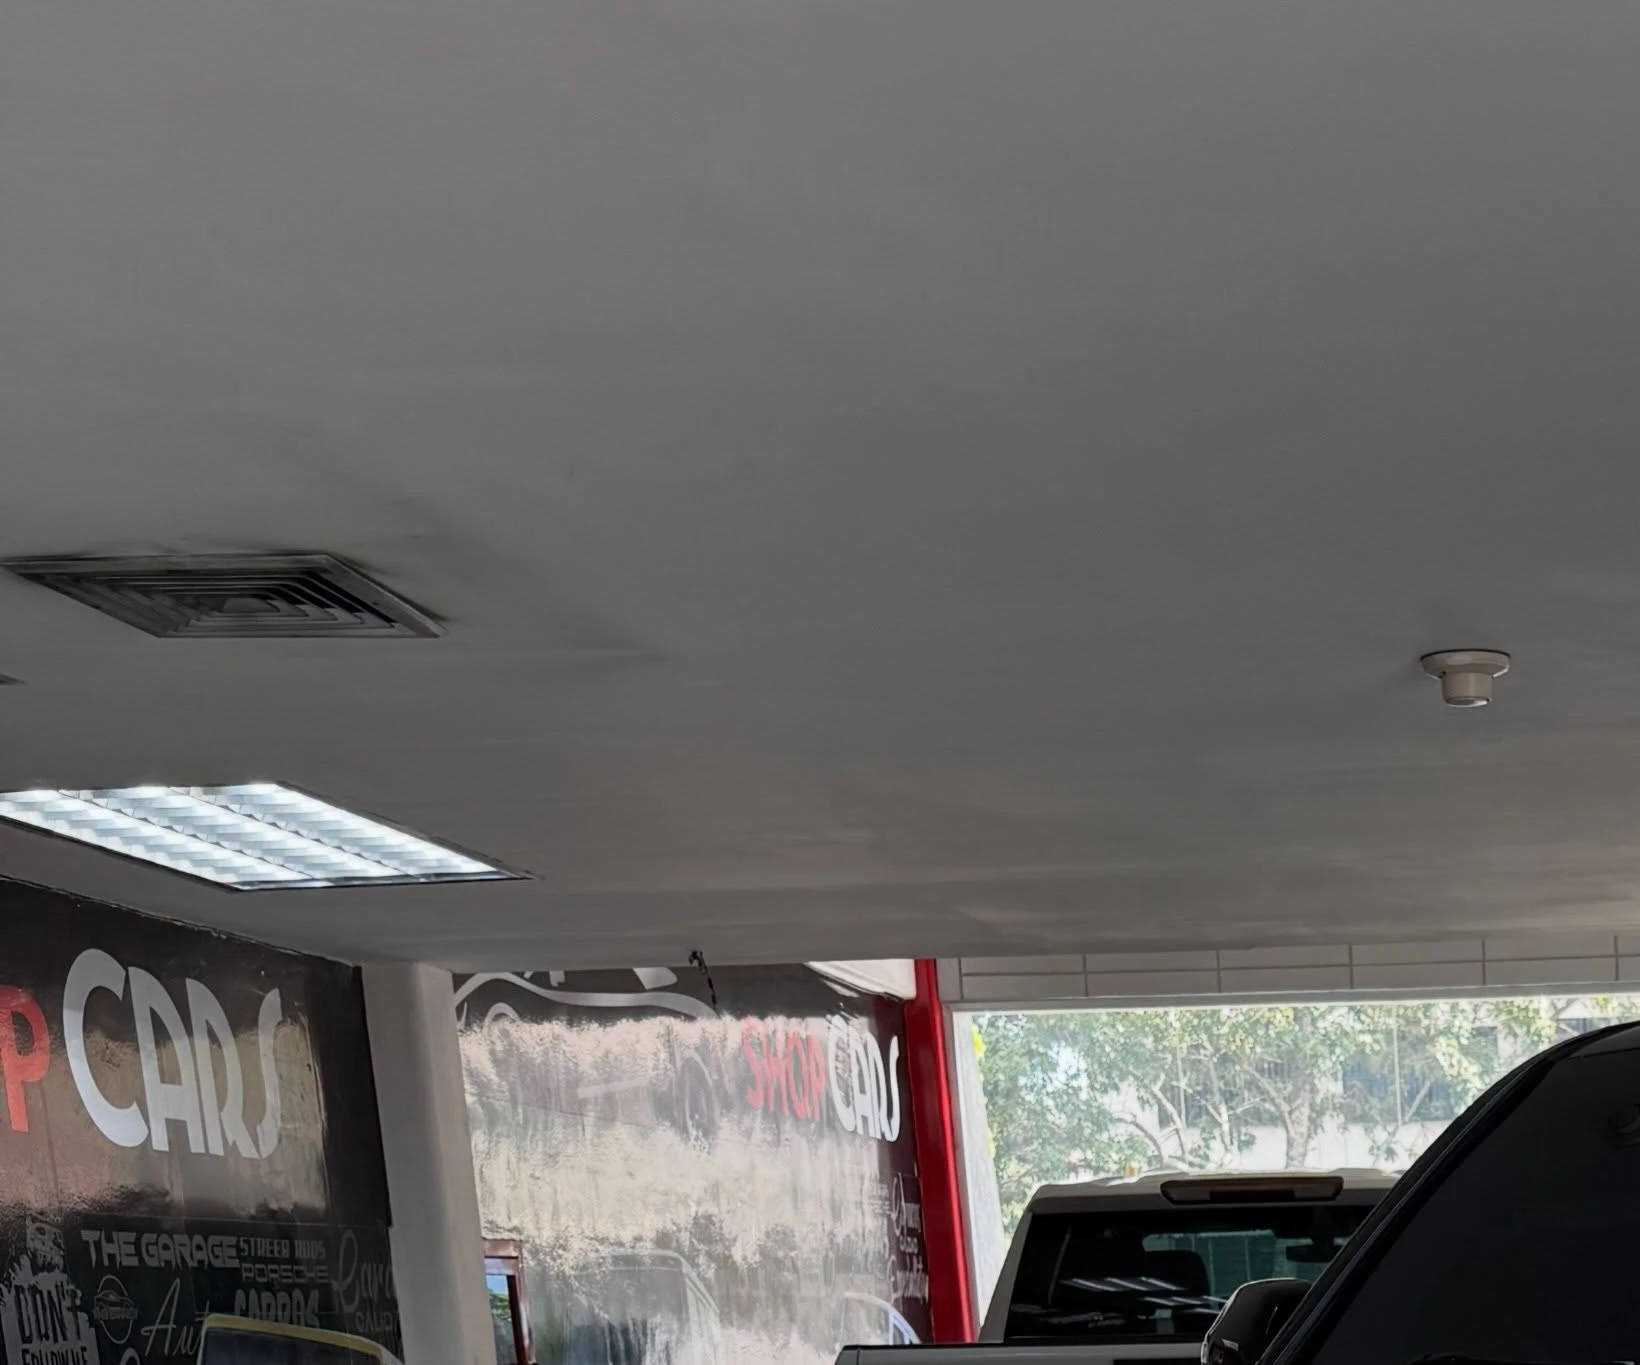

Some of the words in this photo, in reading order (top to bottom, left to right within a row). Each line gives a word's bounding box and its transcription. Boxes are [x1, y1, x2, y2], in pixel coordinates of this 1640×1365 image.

[63, 948, 281, 1160] CARS
[742, 1016, 825, 1121] SHOP
[828, 1014, 900, 1142] CARS
[80, 1228, 140, 1270] THE
[141, 1232, 241, 1272] GARAGE
[241, 1263, 329, 1283] PORSCHE
